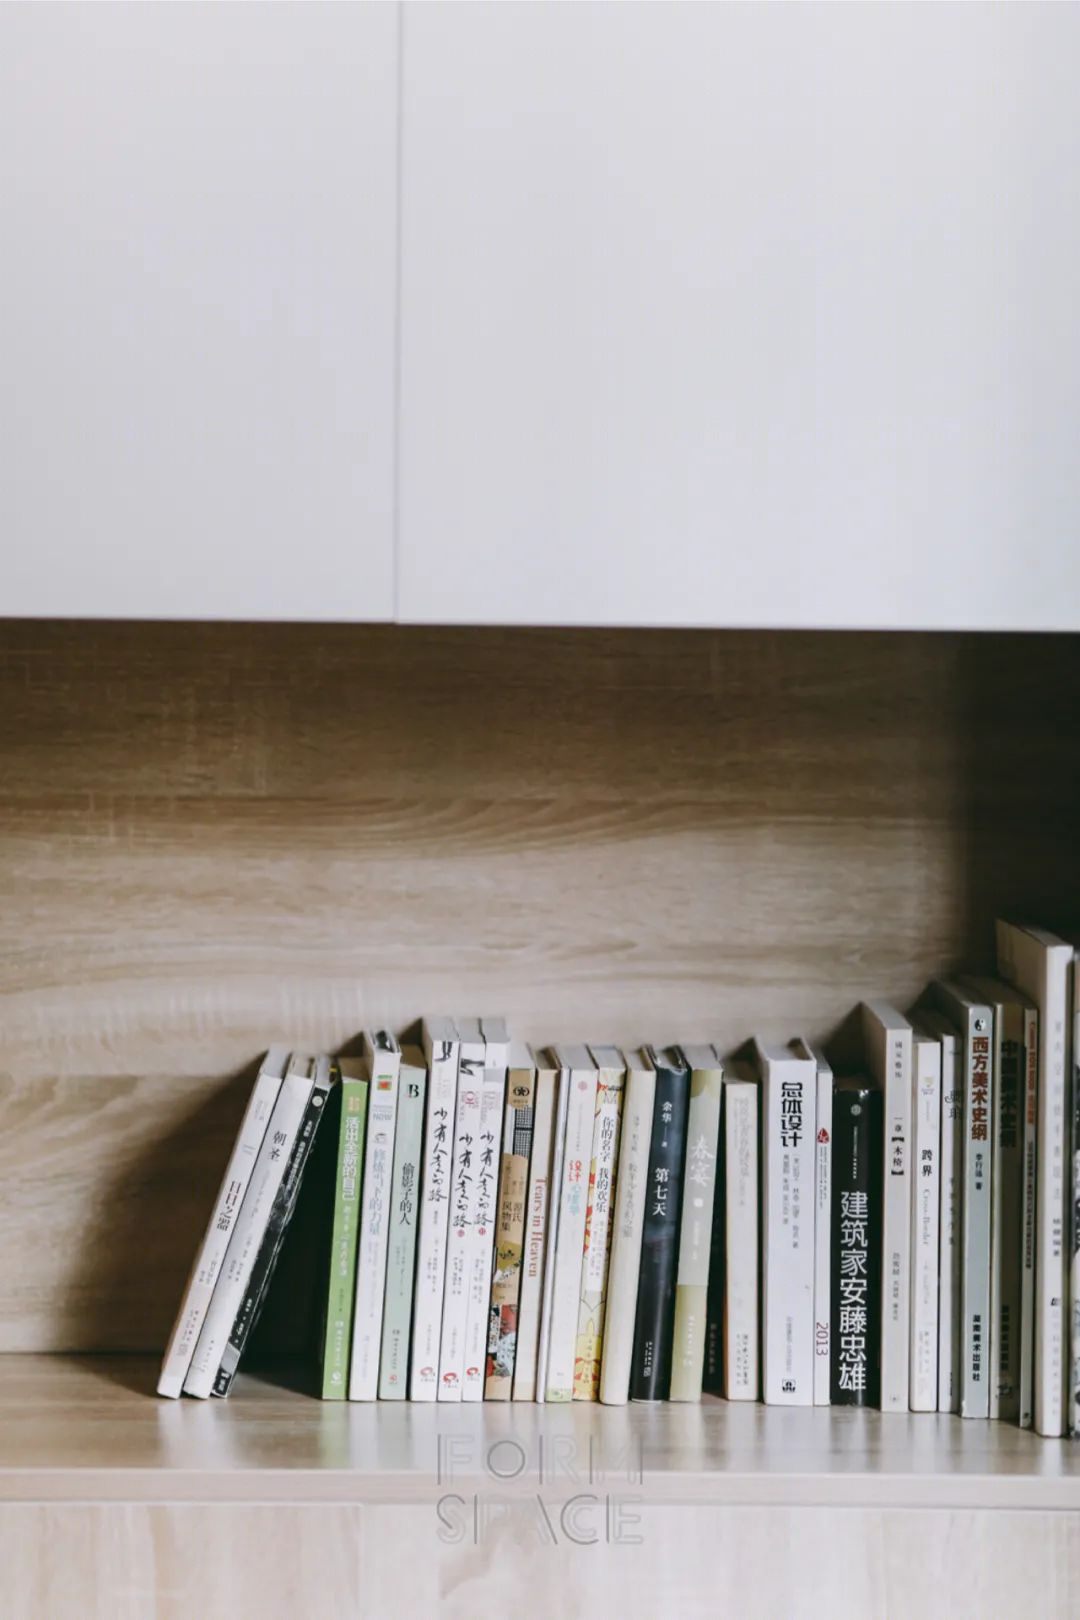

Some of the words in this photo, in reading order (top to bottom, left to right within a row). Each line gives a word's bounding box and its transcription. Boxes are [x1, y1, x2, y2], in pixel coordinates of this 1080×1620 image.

[408, 1083, 421, 1098] B
[661, 1101, 673, 1124] 余华
[971, 1036, 989, 1142] 西方美术史纲
[600, 1116, 615, 1163] 你的名字
[781, 1081, 803, 1148] 总体设计
[268, 1130, 288, 1163] 朝圣
[342, 1116, 361, 1201] 活出全新的自己
[428, 1107, 448, 1202] 少有人走的路
[690, 1133, 715, 1189] 春宴
[921, 1149, 933, 1177] 跨界
[399, 1162, 415, 1226] 偷影子的人
[452, 1132, 473, 1228] 少有人走的路
[473, 1130, 495, 1226] 少有人走的路
[533, 1178, 548, 1212] Tears
[652, 1167, 670, 1217] 第七天
[532, 1215, 545, 1228] in
[528, 1231, 543, 1278] Heaven
[838, 1191, 869, 1392] 建筑家安藤忠雄
[815, 1321, 829, 1356] 2013
